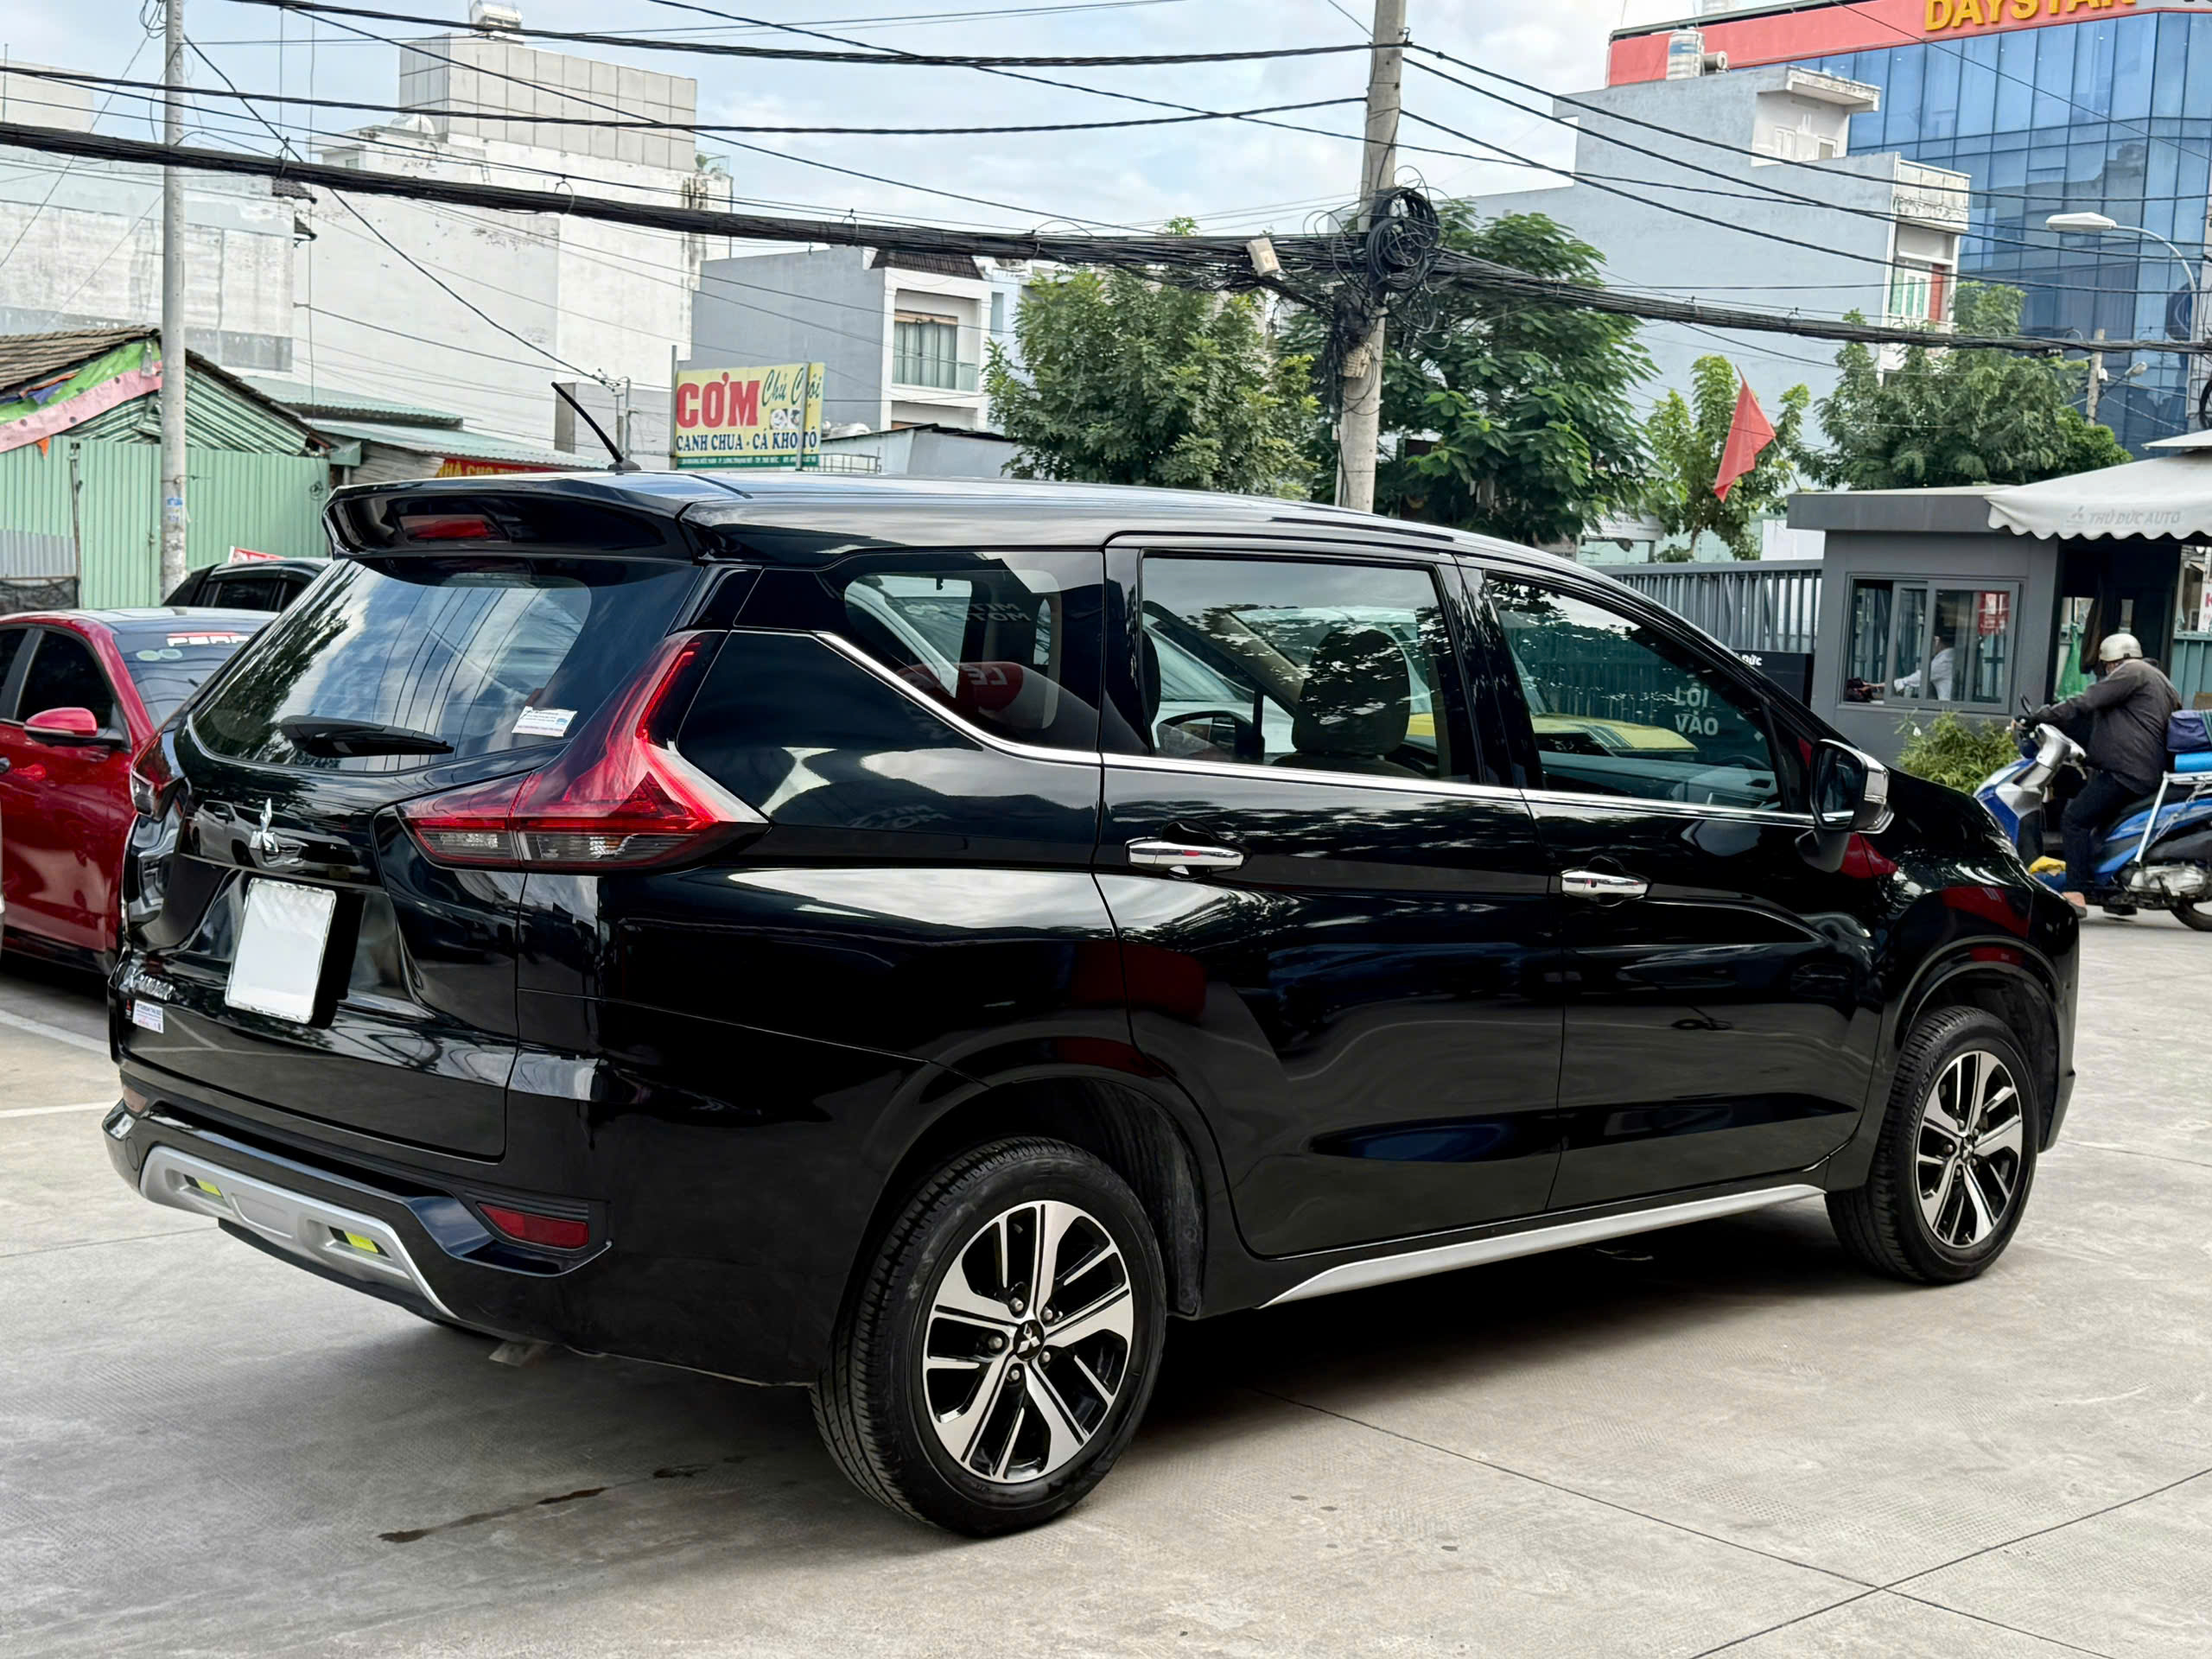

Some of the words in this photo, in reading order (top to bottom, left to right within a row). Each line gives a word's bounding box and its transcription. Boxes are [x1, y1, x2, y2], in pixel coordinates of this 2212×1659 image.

[677, 372, 760, 429] CƠM
[677, 434, 709, 451] CANH
[711, 433, 743, 450] CHUA
[753, 428, 768, 449] CÁ
[772, 431, 798, 449] KHO
[2144, 511, 2181, 524] AUTO
